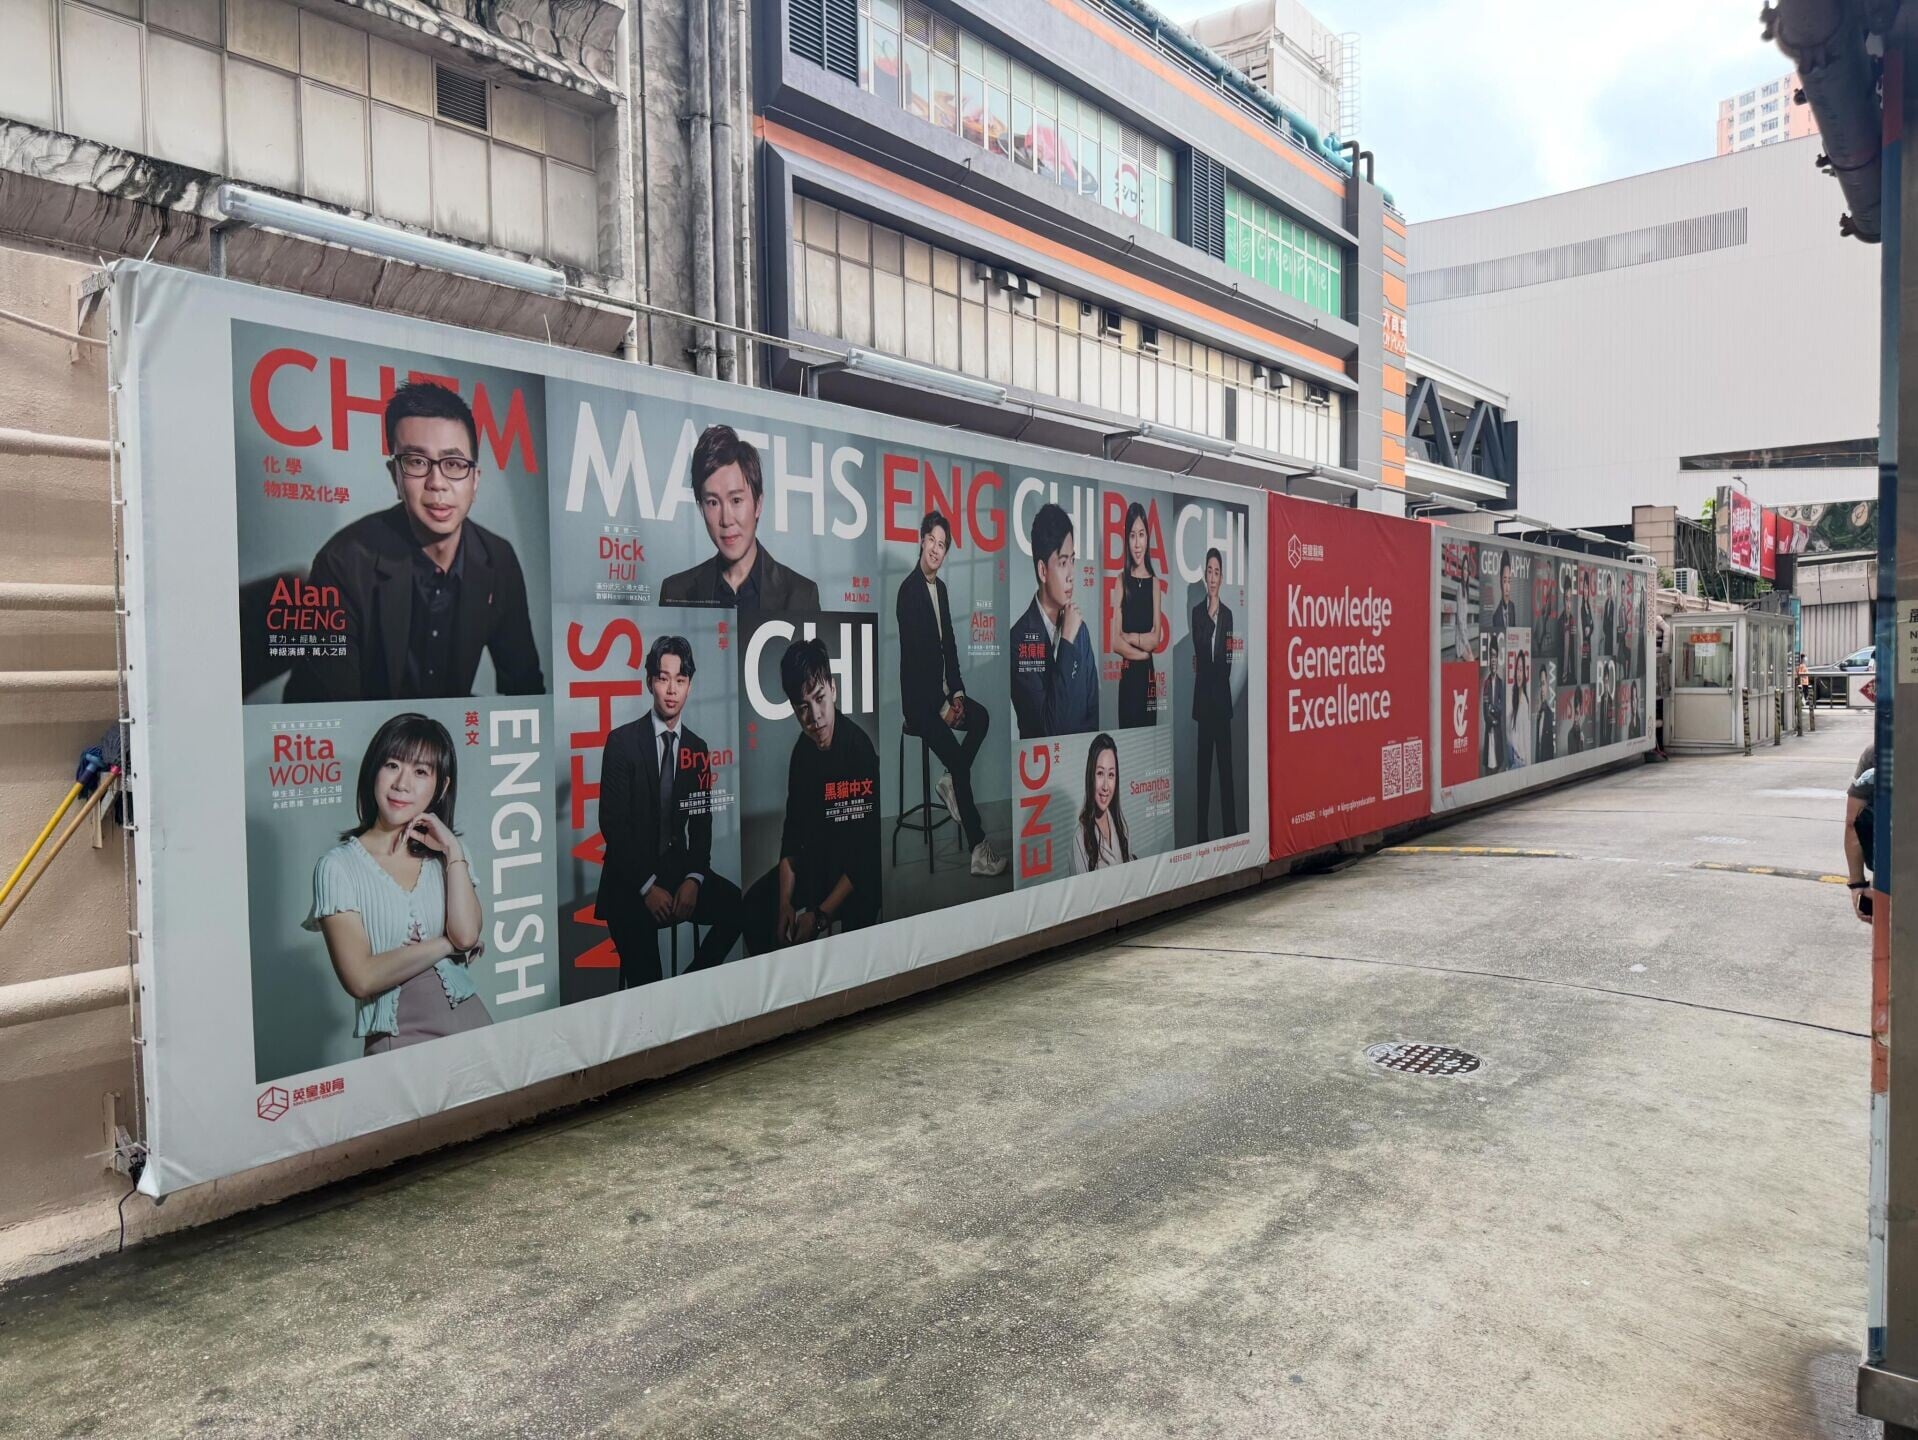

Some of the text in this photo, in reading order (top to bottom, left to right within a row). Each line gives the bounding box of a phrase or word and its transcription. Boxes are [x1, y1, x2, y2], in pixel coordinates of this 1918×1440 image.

[250, 347, 539, 474] CHM
[263, 456, 303, 475] 化學
[263, 481, 350, 504] 物理及化學
[883, 453, 1007, 553] ENG
[1012, 477, 1095, 562] CHI
[599, 535, 645, 562] Dick
[1175, 504, 1245, 586] CHI
[608, 562, 637, 581] HUI
[1481, 550, 1531, 579] GEOAPHY
[269, 577, 340, 607] Alan
[266, 608, 346, 631] CHENG
[972, 613, 997, 629] Alan
[1288, 584, 1392, 636] Knowledge
[744, 620, 873, 720] CHI
[1288, 636, 1386, 681] Generates
[1507, 650, 1530, 685] EG
[1596, 659, 1616, 703] BO
[1288, 683, 1391, 733] Excellence
[465, 711, 480, 747] 英文
[273, 733, 335, 763] Rita
[680, 748, 733, 772] Bryan
[268, 762, 342, 788] WONG
[697, 772, 719, 790] YIP
[825, 778, 873, 801] 黑貓中文
[1130, 776, 1170, 796] Samantha
[1018, 744, 1053, 880] ENG
[489, 708, 546, 1006] ENGLISH
